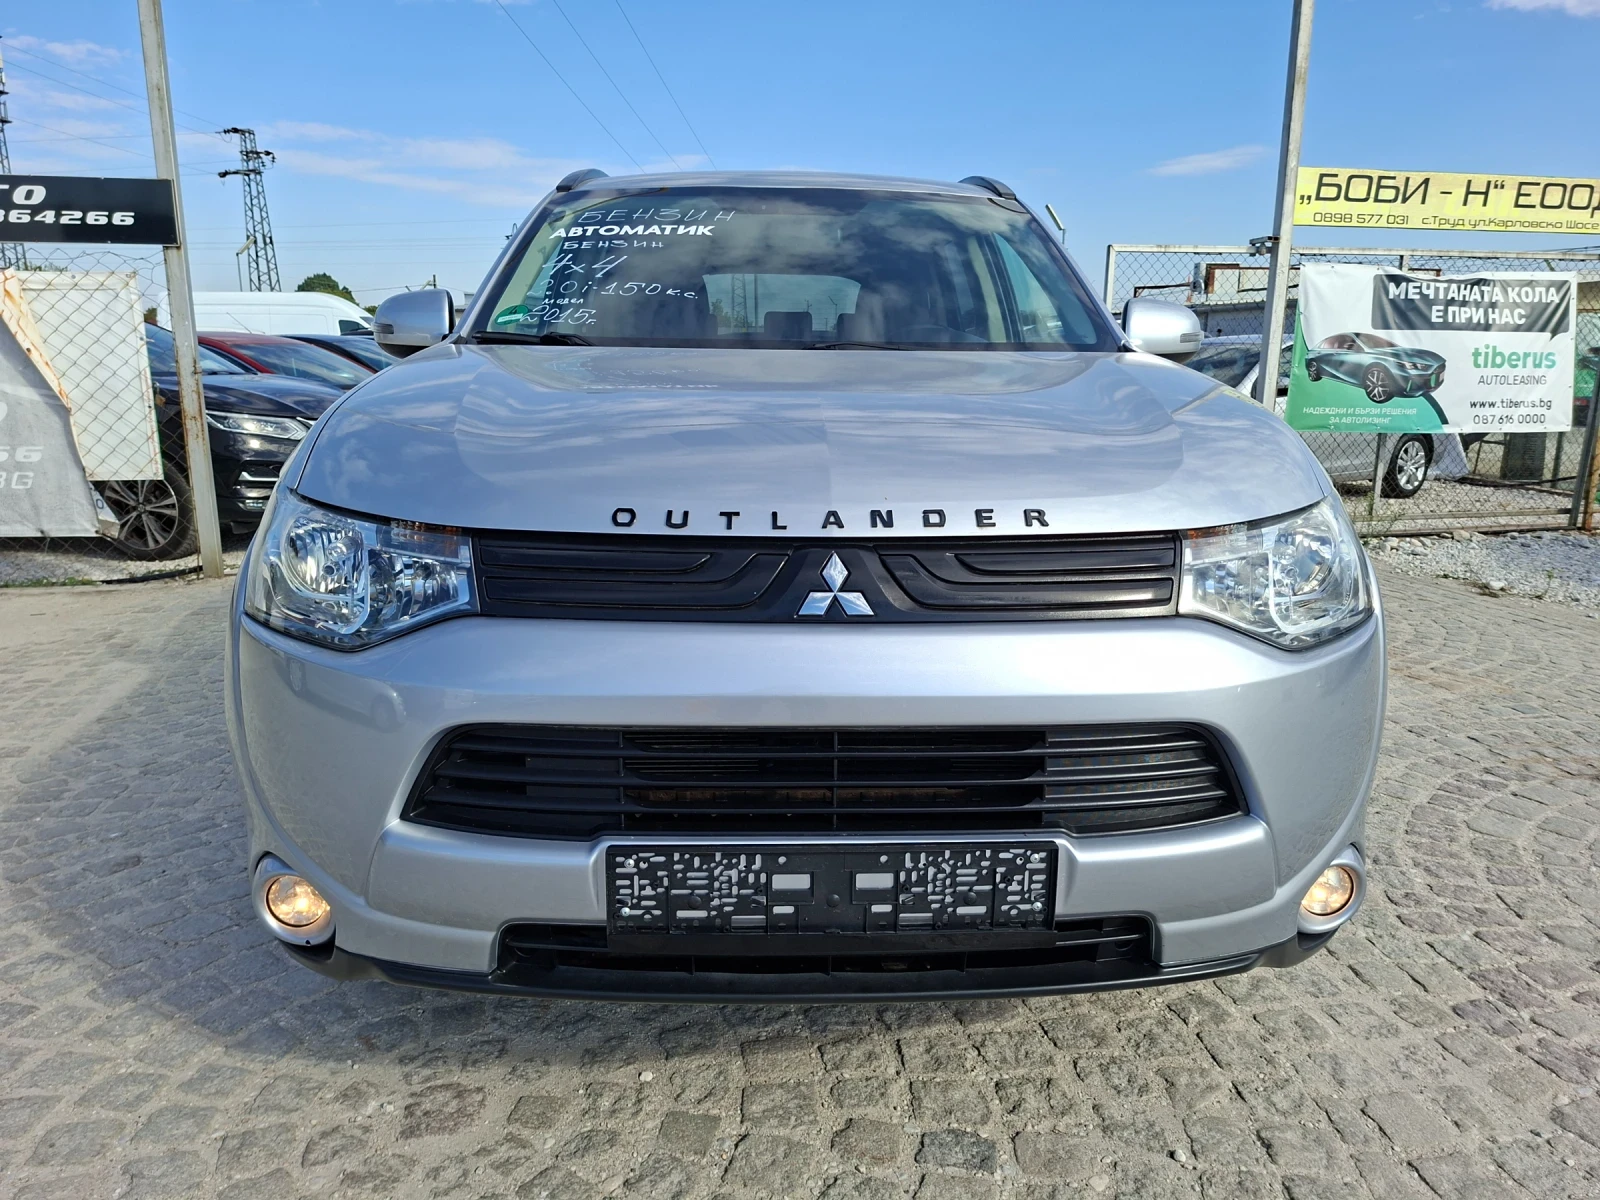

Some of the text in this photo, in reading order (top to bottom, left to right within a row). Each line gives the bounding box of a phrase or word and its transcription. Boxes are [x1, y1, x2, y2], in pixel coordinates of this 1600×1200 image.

[0, 184, 47, 205] О
[0, 209, 135, 226] 64266
[577, 208, 736, 223] БЕНЗИН
[1313, 212, 1409, 225] 0898 577 031
[1421, 216, 1465, 228] с.Труд
[1566, 220, 1600, 230] Шосе
[549, 225, 716, 239] АВТОМАТИК
[562, 240, 664, 250] БЕНЗИН
[1388, 282, 1560, 303] МЕЧТАНАТА КОЛА
[1431, 305, 1527, 325] Е ПРИ НАС
[1471, 344, 1557, 369] tiberus
[1477, 375, 1547, 385] AUTOLEASING
[1303, 406, 1347, 415] НАДЕЖДНИ
[1355, 407, 1380, 415] БЪРЗИ
[1381, 407, 1417, 415] РЕШЕНИЯ
[1469, 398, 1552, 410] www.tiberus.bg
[1341, 416, 1391, 424] АВТОЛИЗИНГ
[1473, 414, 1546, 424] 087 616 0000
[611, 507, 1050, 530] OUTLANDER
